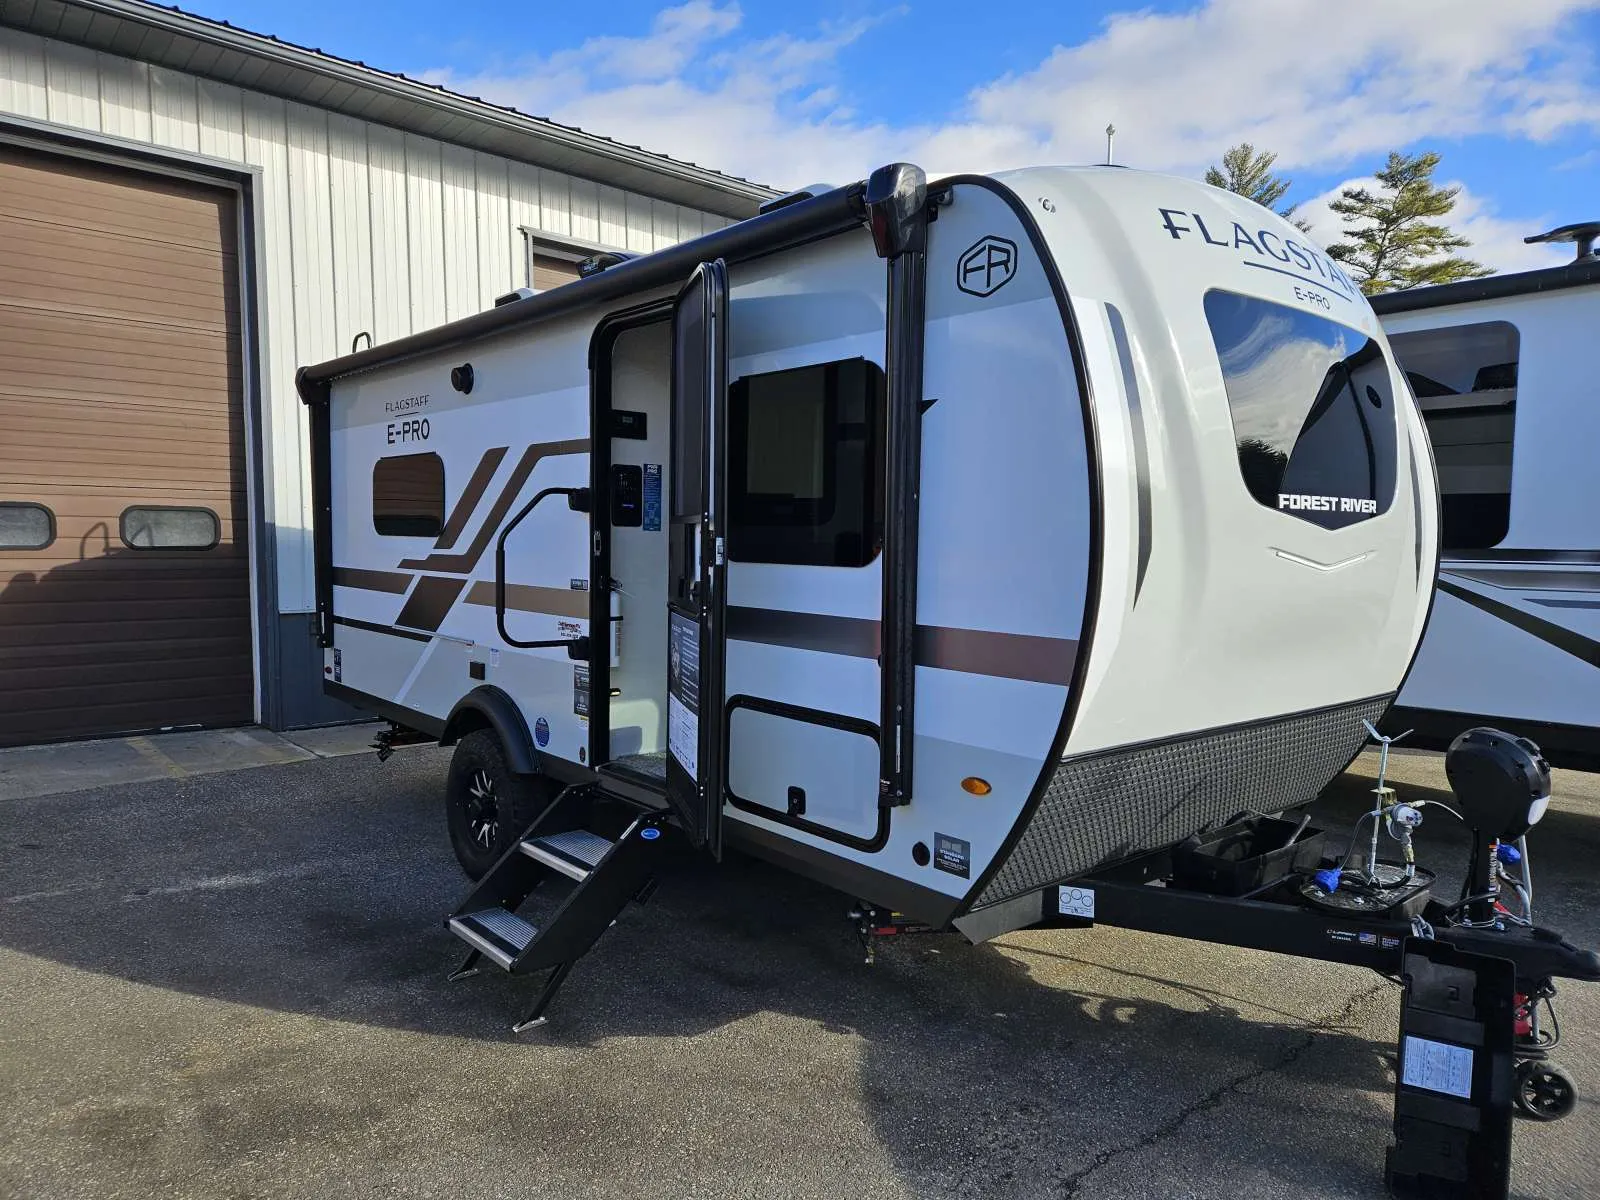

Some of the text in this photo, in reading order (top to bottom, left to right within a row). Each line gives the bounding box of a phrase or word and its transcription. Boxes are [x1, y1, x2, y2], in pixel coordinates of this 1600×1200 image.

[1294, 286, 1331, 310] E-PRO
[385, 394, 430, 412] FLAGSTAFF
[387, 418, 430, 444] E-PRO
[1278, 493, 1377, 513] FOREST RIVER
